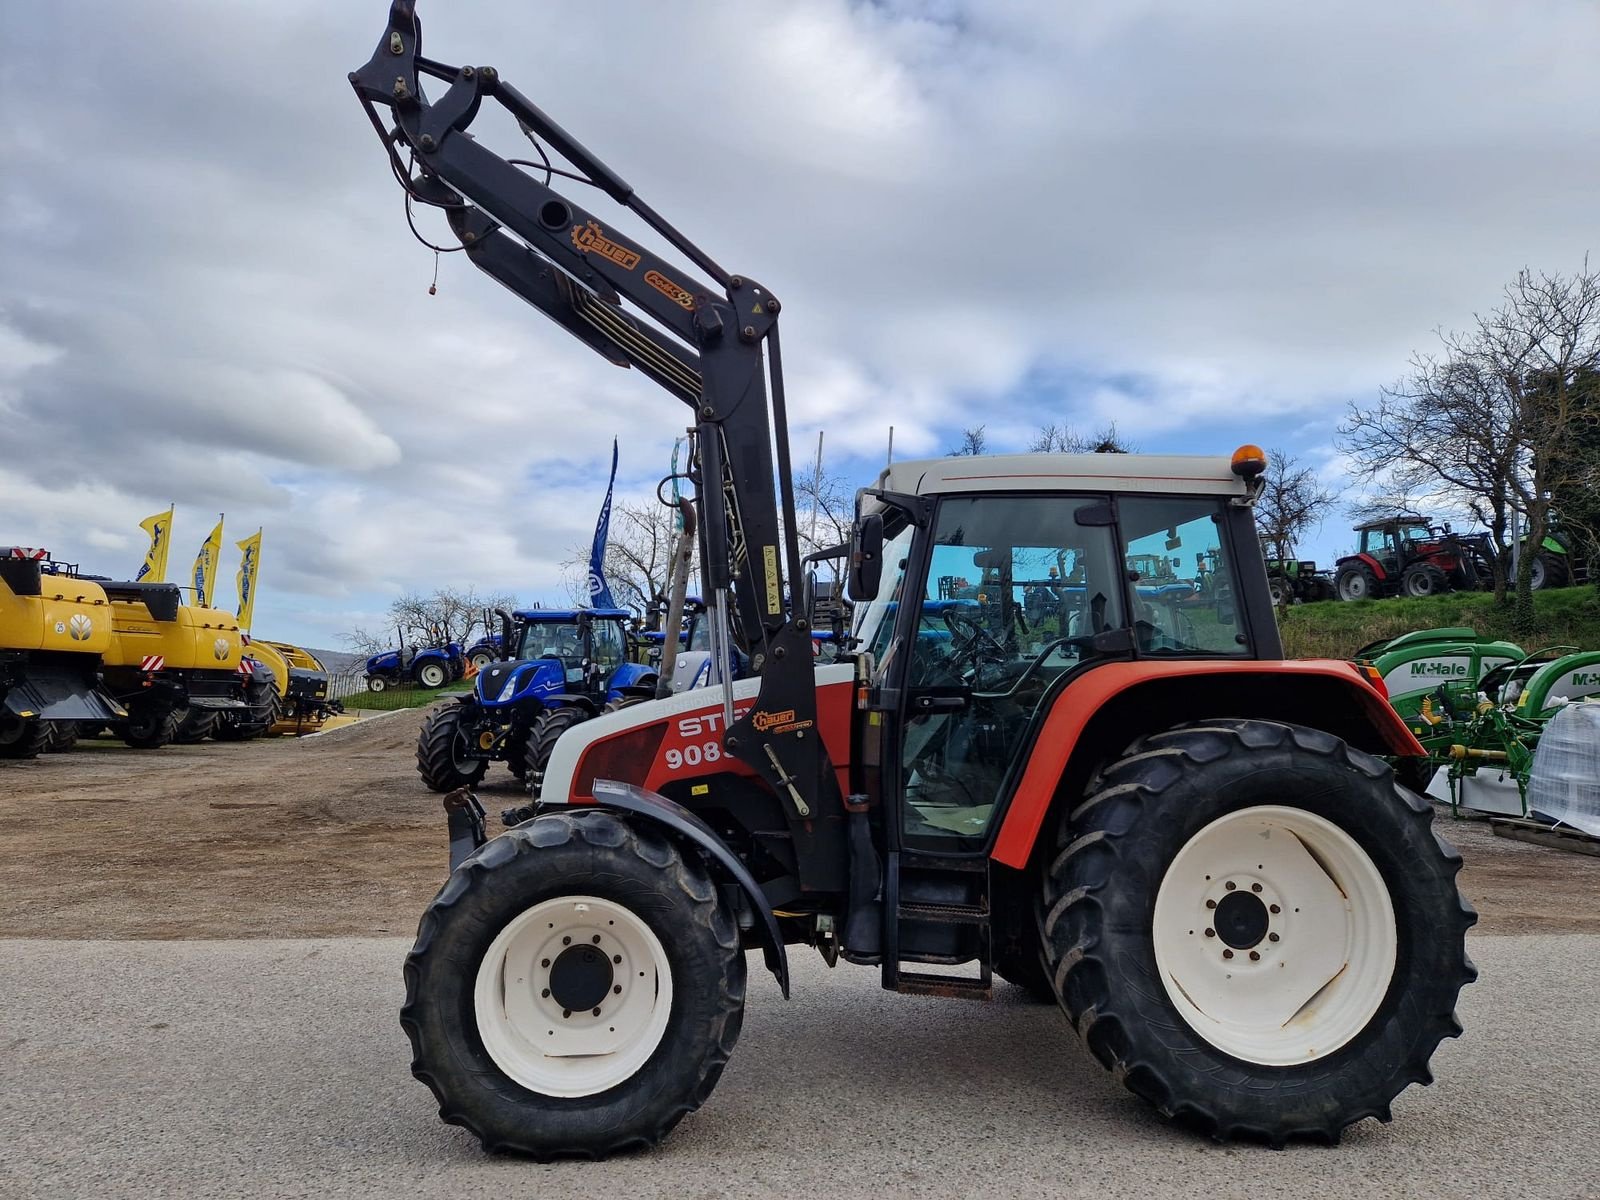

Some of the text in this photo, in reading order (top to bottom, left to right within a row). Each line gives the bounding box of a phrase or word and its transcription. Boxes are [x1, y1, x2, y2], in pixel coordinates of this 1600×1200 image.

[577, 227, 637, 268] hauer
[1411, 662, 1466, 675] McHale
[758, 711, 793, 727] hauer
[665, 741, 734, 769] 908
